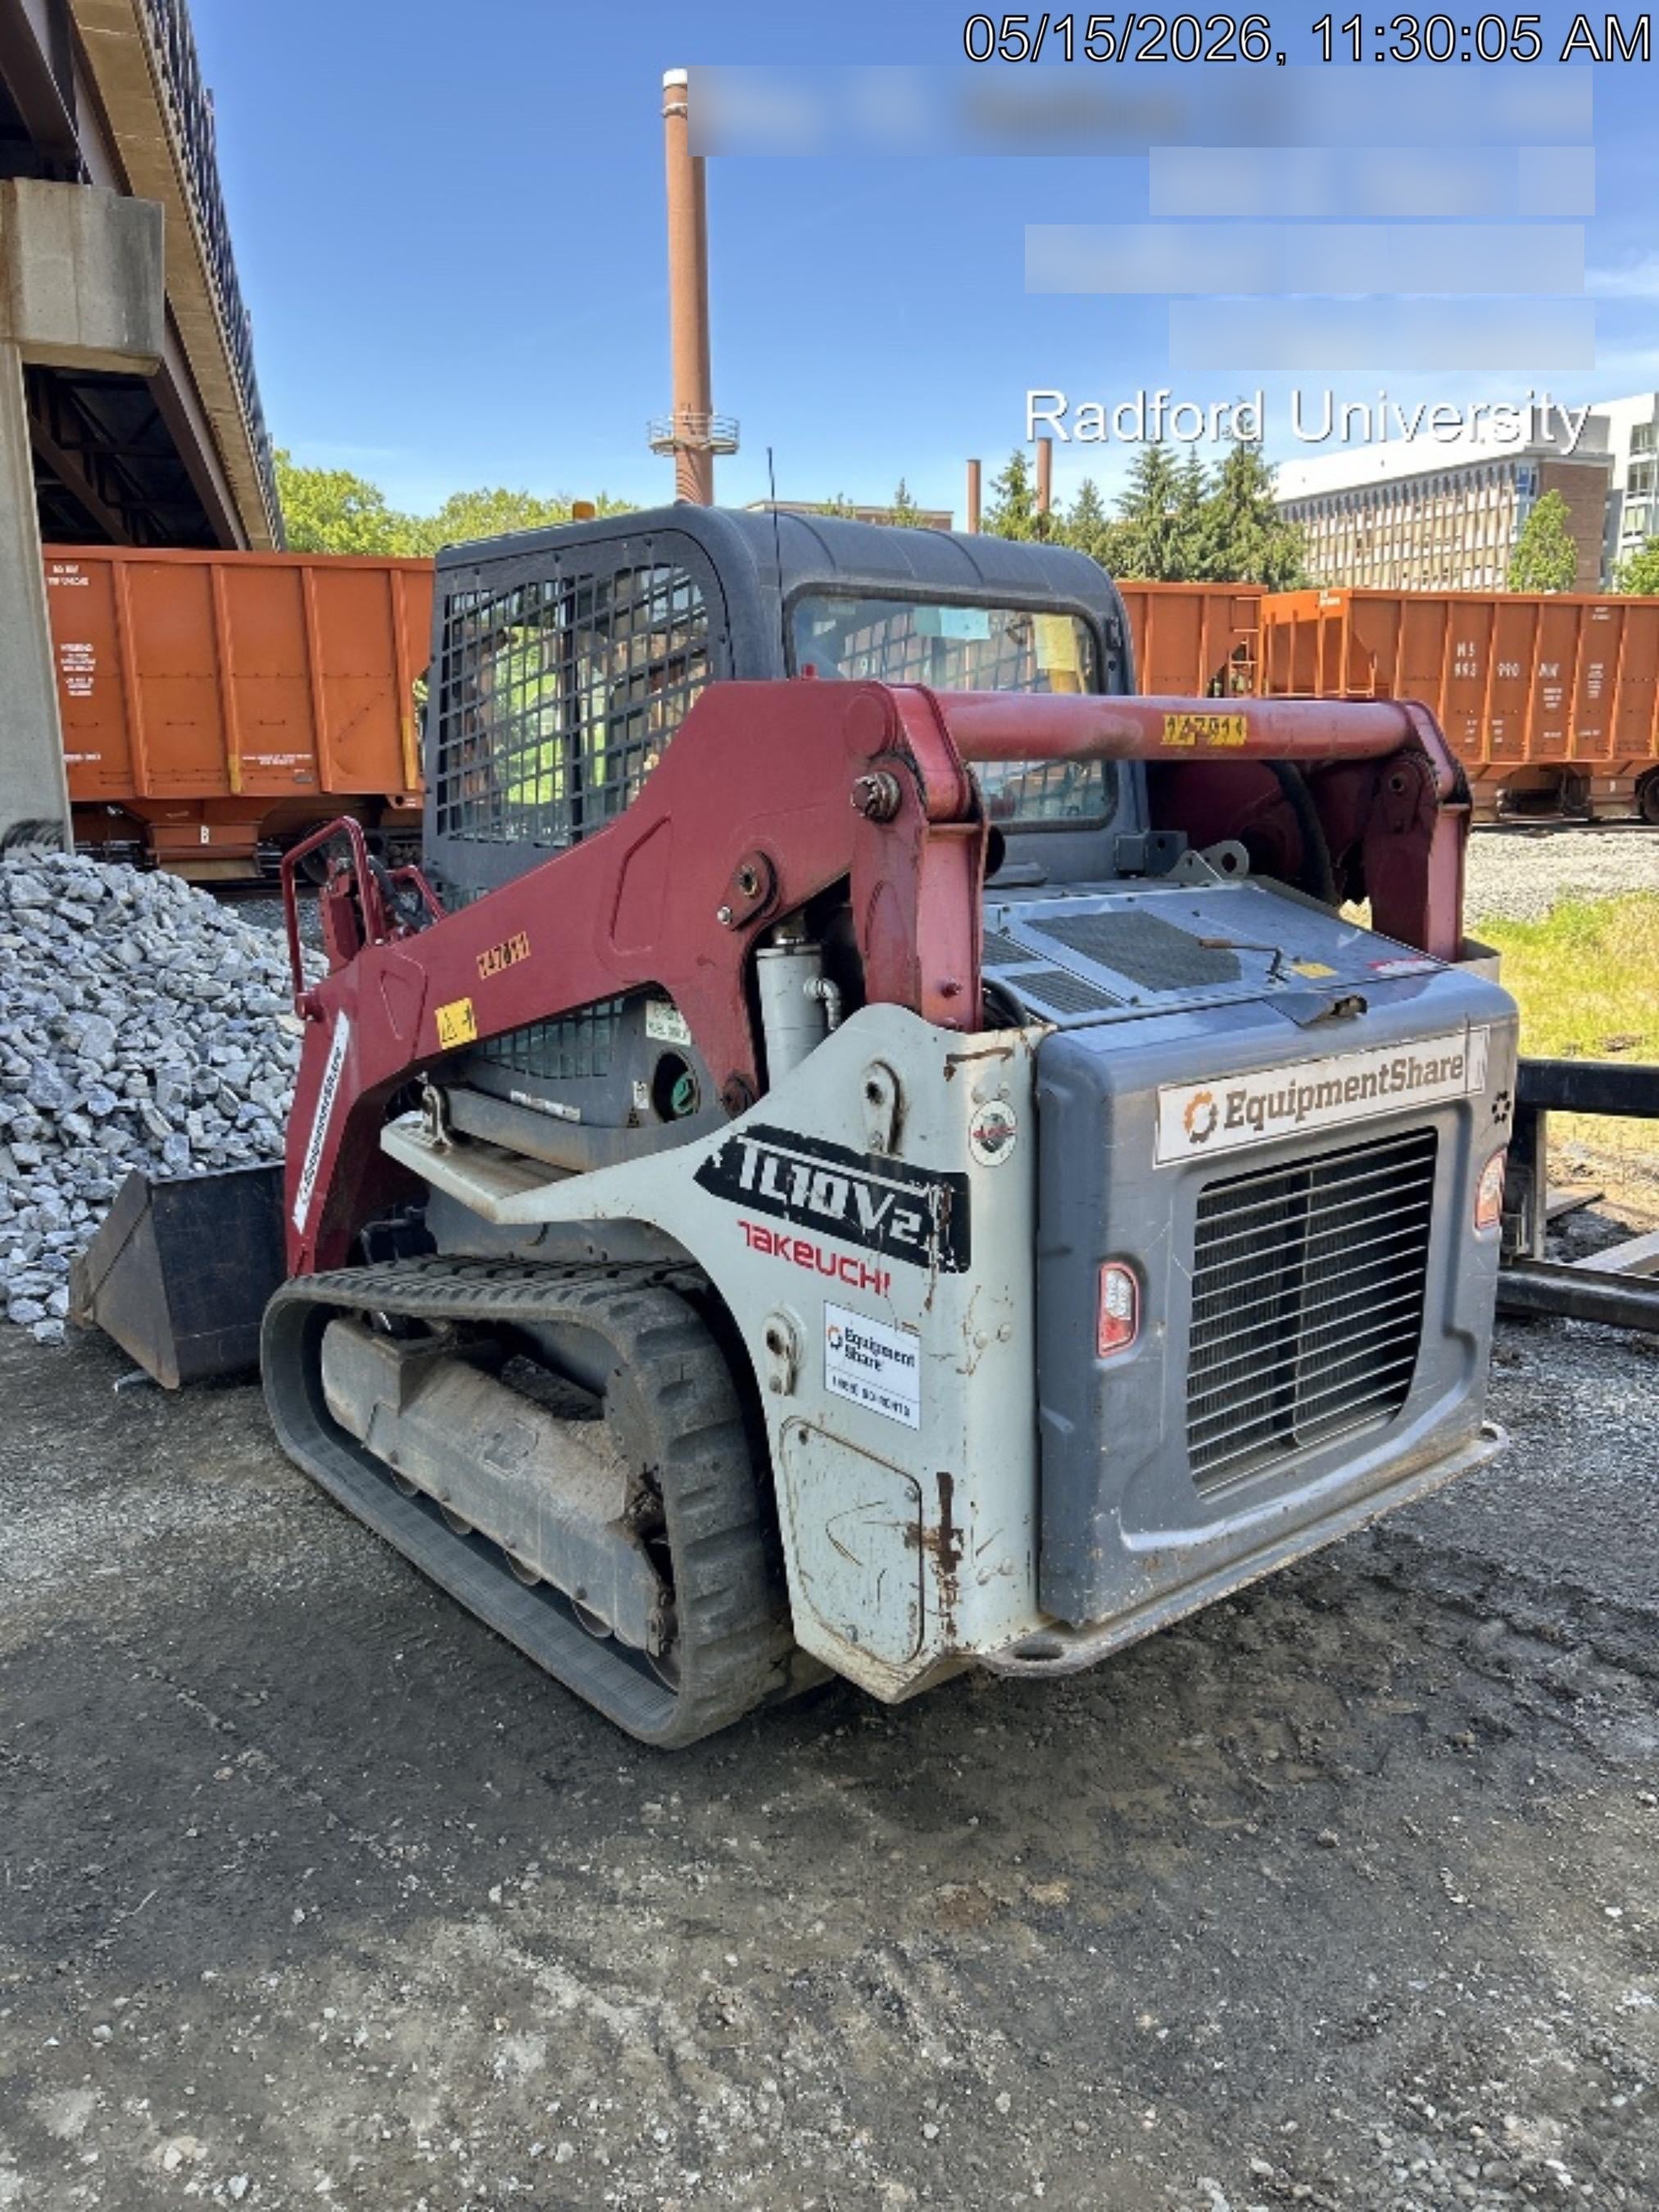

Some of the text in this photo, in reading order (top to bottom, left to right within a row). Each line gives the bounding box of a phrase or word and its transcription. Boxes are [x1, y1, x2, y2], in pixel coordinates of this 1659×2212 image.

[200, 825, 210, 844] B
[1223, 1054, 1464, 1131] EquipmentShare
[845, 1326, 915, 1368] Equipment
[845, 1344, 882, 1372] Share
